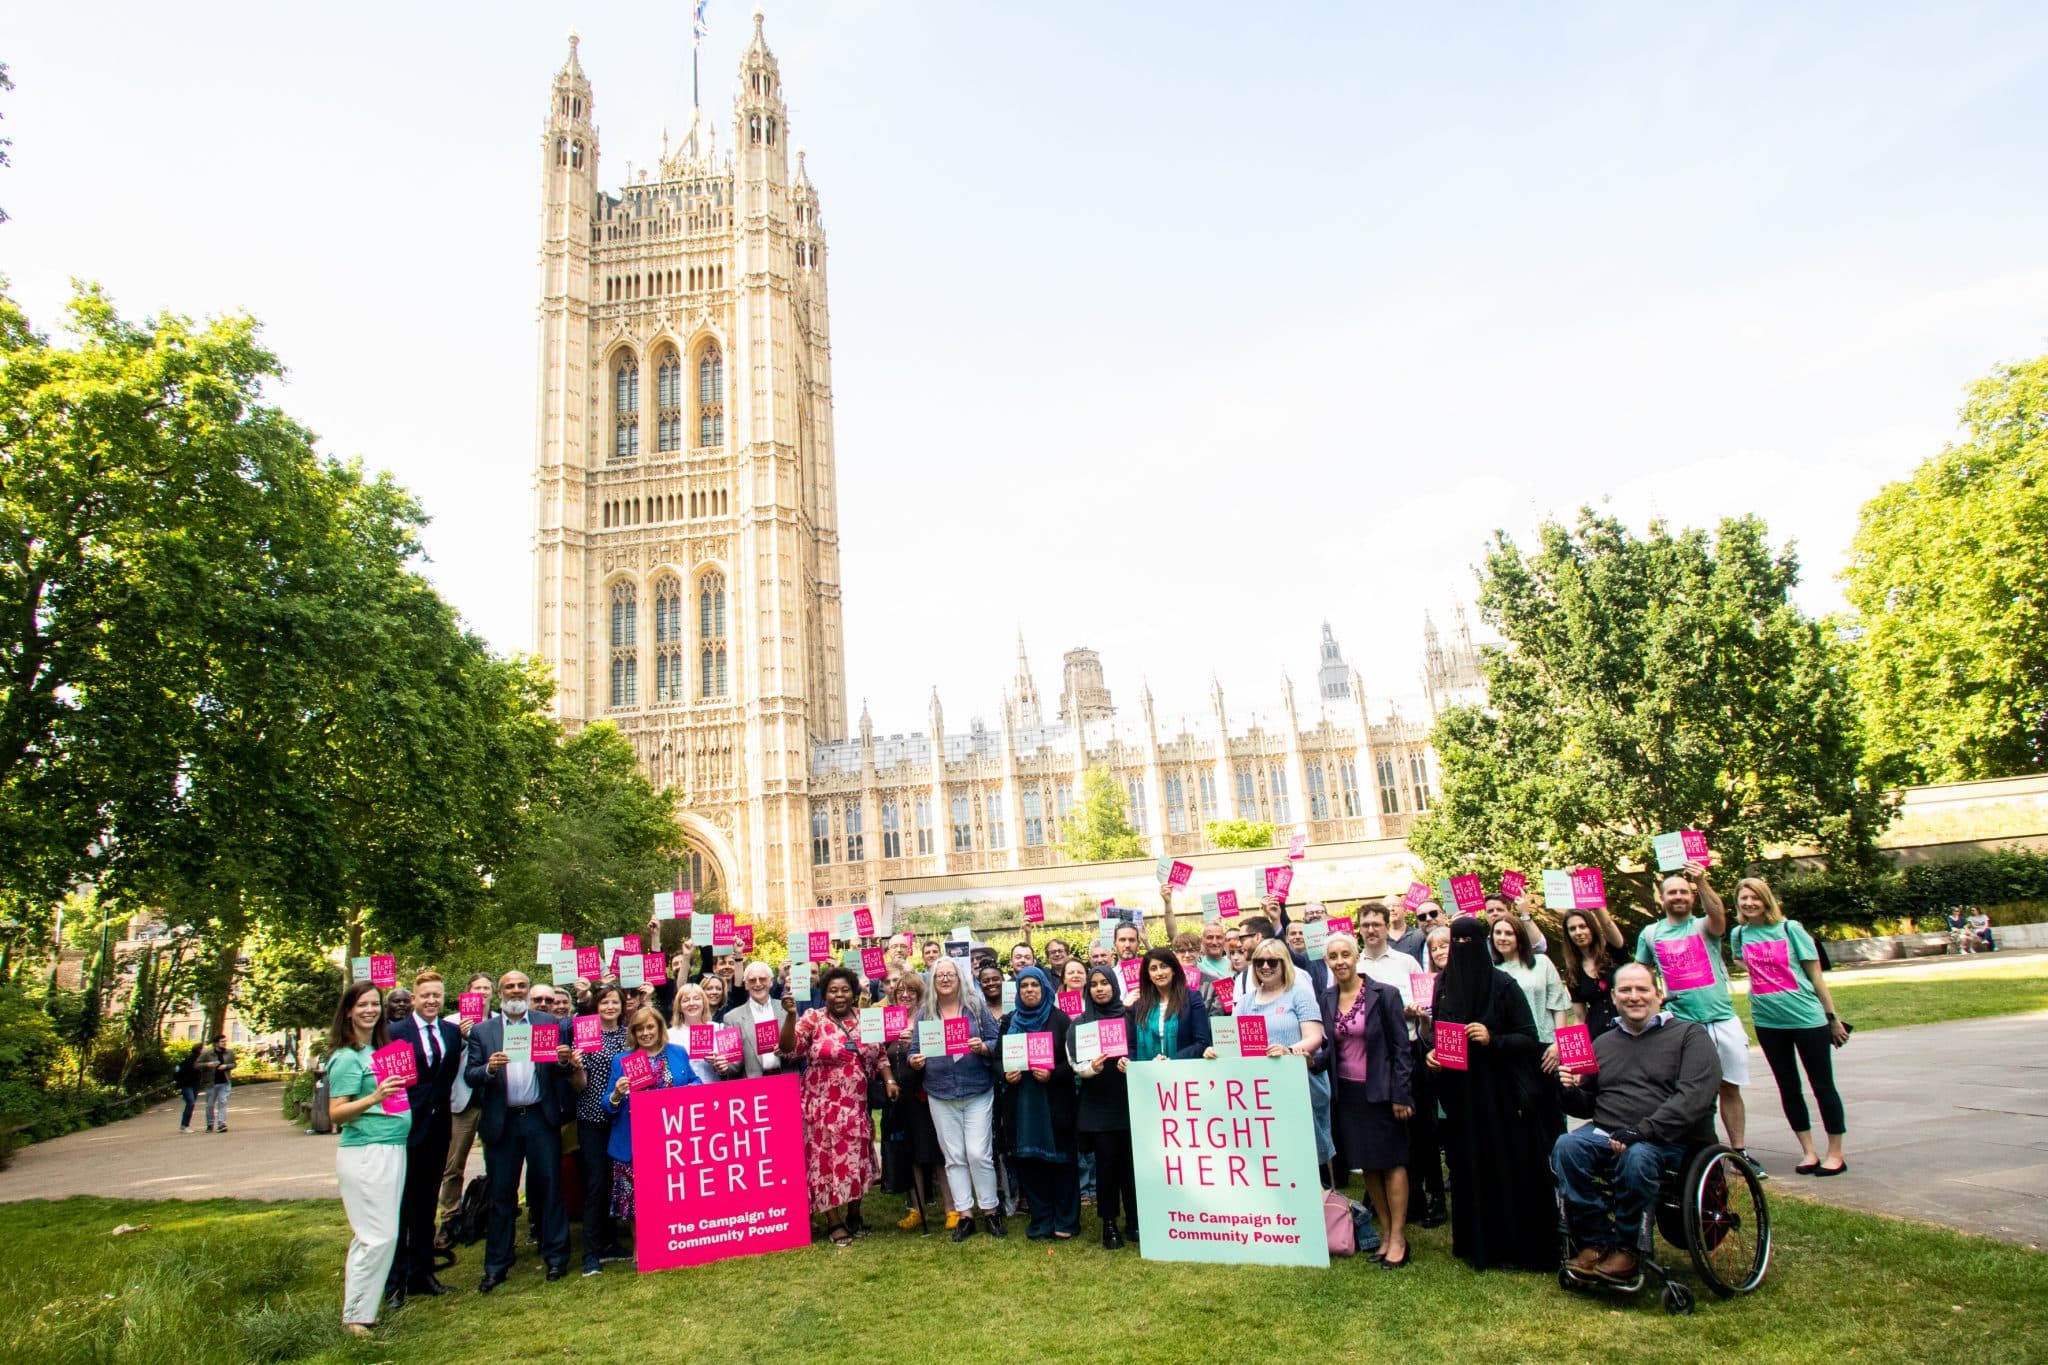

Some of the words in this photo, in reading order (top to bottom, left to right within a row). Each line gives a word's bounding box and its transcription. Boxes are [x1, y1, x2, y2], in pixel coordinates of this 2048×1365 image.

[1560, 1040, 1586, 1051] RIGHT
[1157, 1078, 1273, 1112] WE'RE
[662, 1095, 769, 1135] WE'RE
[665, 1127, 772, 1168] RIGHT
[1162, 1117, 1275, 1149] RIGHT
[667, 1159, 787, 1202] HERE.
[1165, 1155, 1296, 1189] HERE.
[668, 1223, 695, 1235] The
[698, 1210, 765, 1230] Campaign
[768, 1207, 787, 1218] for
[1168, 1211, 1195, 1223] The
[1199, 1212, 1272, 1228] Campaign
[1276, 1214, 1297, 1226] for
[668, 1229, 744, 1251] Community
[748, 1222, 789, 1237] Power
[1168, 1228, 1249, 1245] Community
[1254, 1230, 1301, 1244] Power
